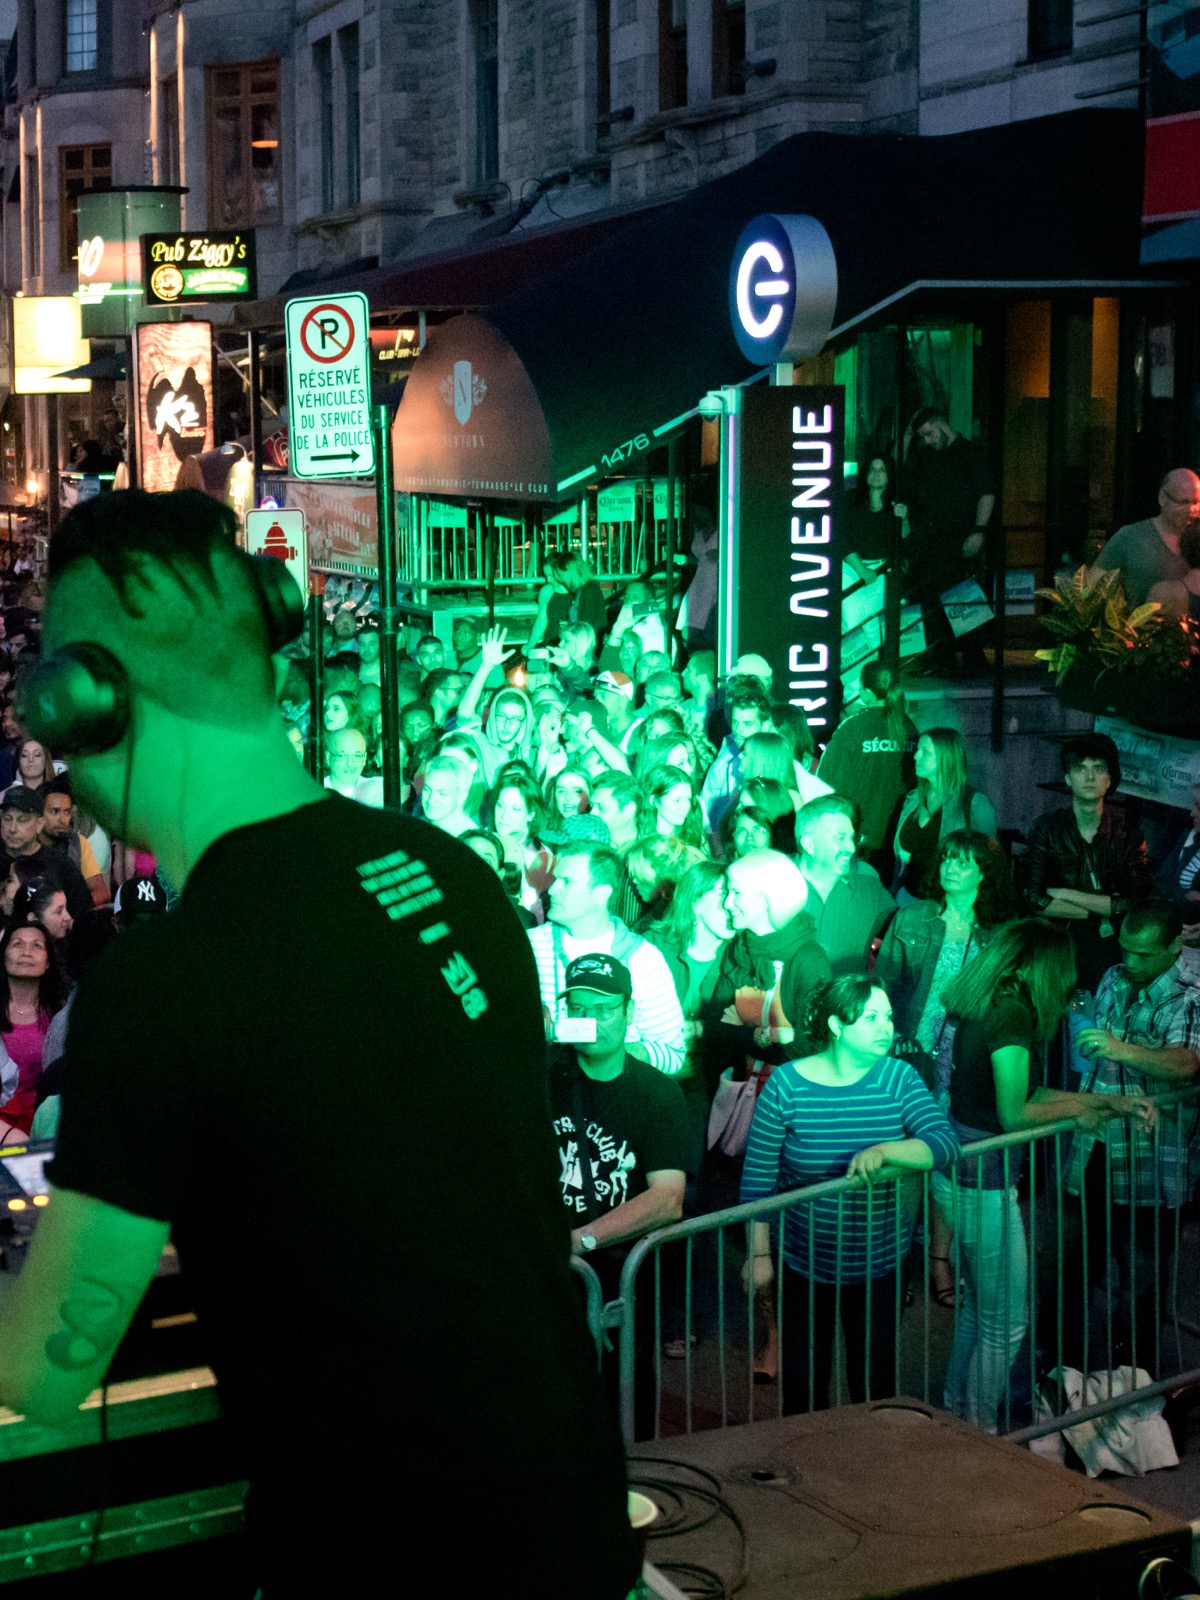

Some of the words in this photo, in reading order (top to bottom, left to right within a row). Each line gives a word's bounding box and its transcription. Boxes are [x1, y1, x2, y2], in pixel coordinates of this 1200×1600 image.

[152, 238, 184, 262] Pub
[188, 236, 246, 267] Ziggy's
[186, 269, 246, 289] JAMESON
[299, 365, 361, 389] RÉSERVÉ
[297, 390, 365, 409] VÉHICULES
[301, 415, 315, 429] DU
[321, 410, 364, 428] SERVICE
[297, 435, 310, 450] DE
[315, 433, 329, 449] LA
[334, 430, 370, 447] POLICE
[600, 432, 650, 468] 1476
[514, 482, 524, 492] LE
[527, 483, 548, 494] CLUB
[790, 404, 833, 618] AVENUE
[137, 880, 155, 901] NY
[585, 1122, 617, 1163] CLUB
